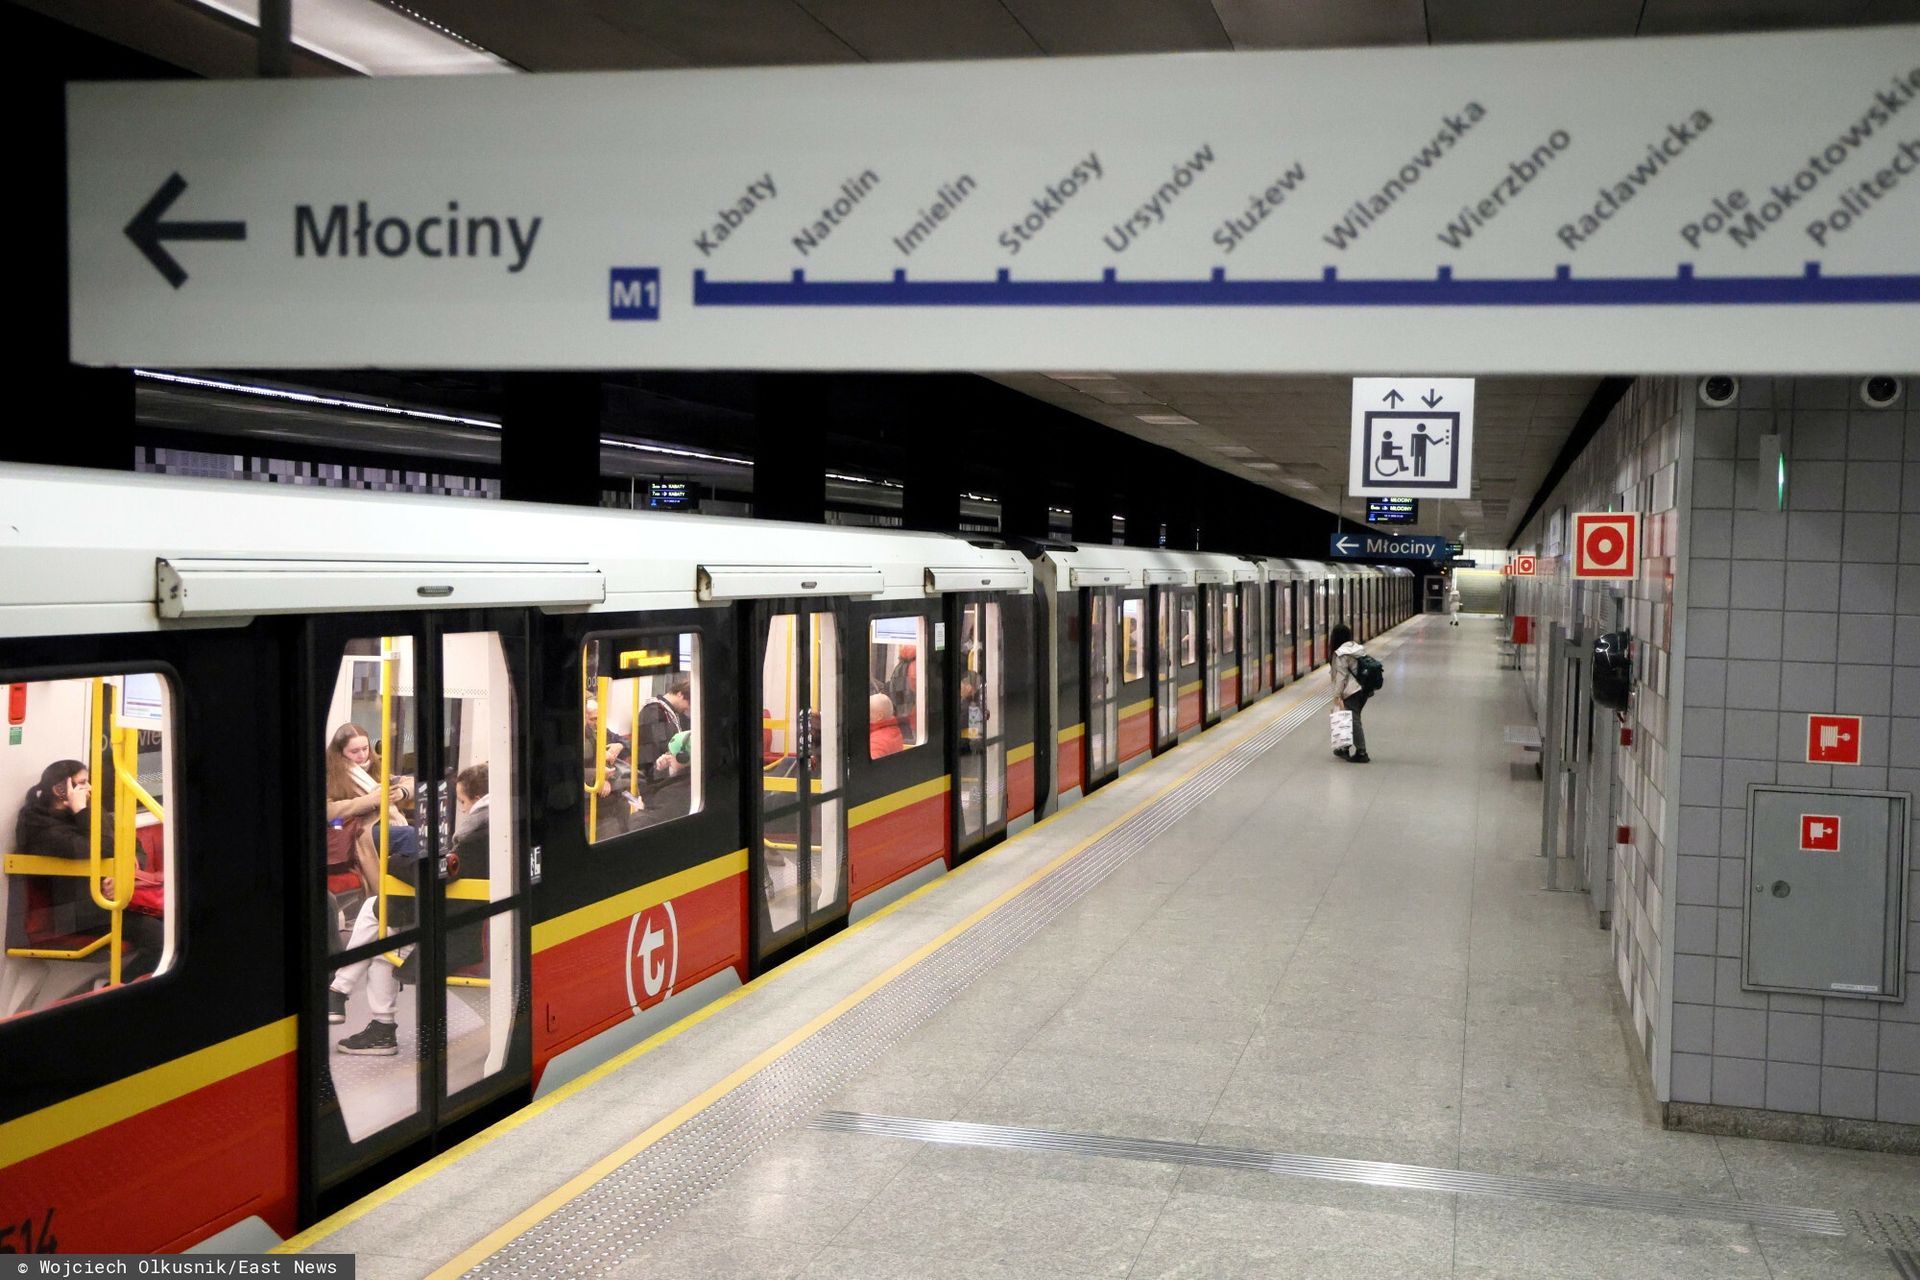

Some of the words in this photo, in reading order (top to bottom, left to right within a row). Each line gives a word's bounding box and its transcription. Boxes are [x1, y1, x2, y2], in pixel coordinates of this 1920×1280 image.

[694, 172, 778, 258] Kabaty
[792, 169, 881, 257] Natolin
[893, 174, 978, 257] Imielin
[998, 152, 1104, 256] Stokłosy
[1103, 143, 1215, 253] Ursynów
[1212, 162, 1307, 254] Służew
[1323, 101, 1487, 251] Wilanowska
[1437, 129, 1571, 250] Wierzbno
[1557, 109, 1714, 252] Racławicka
[1680, 189, 1750, 250] Pole
[294, 200, 544, 275] Młociny
[613, 280, 656, 307] M1
[1366, 539, 1436, 558] Młociny
